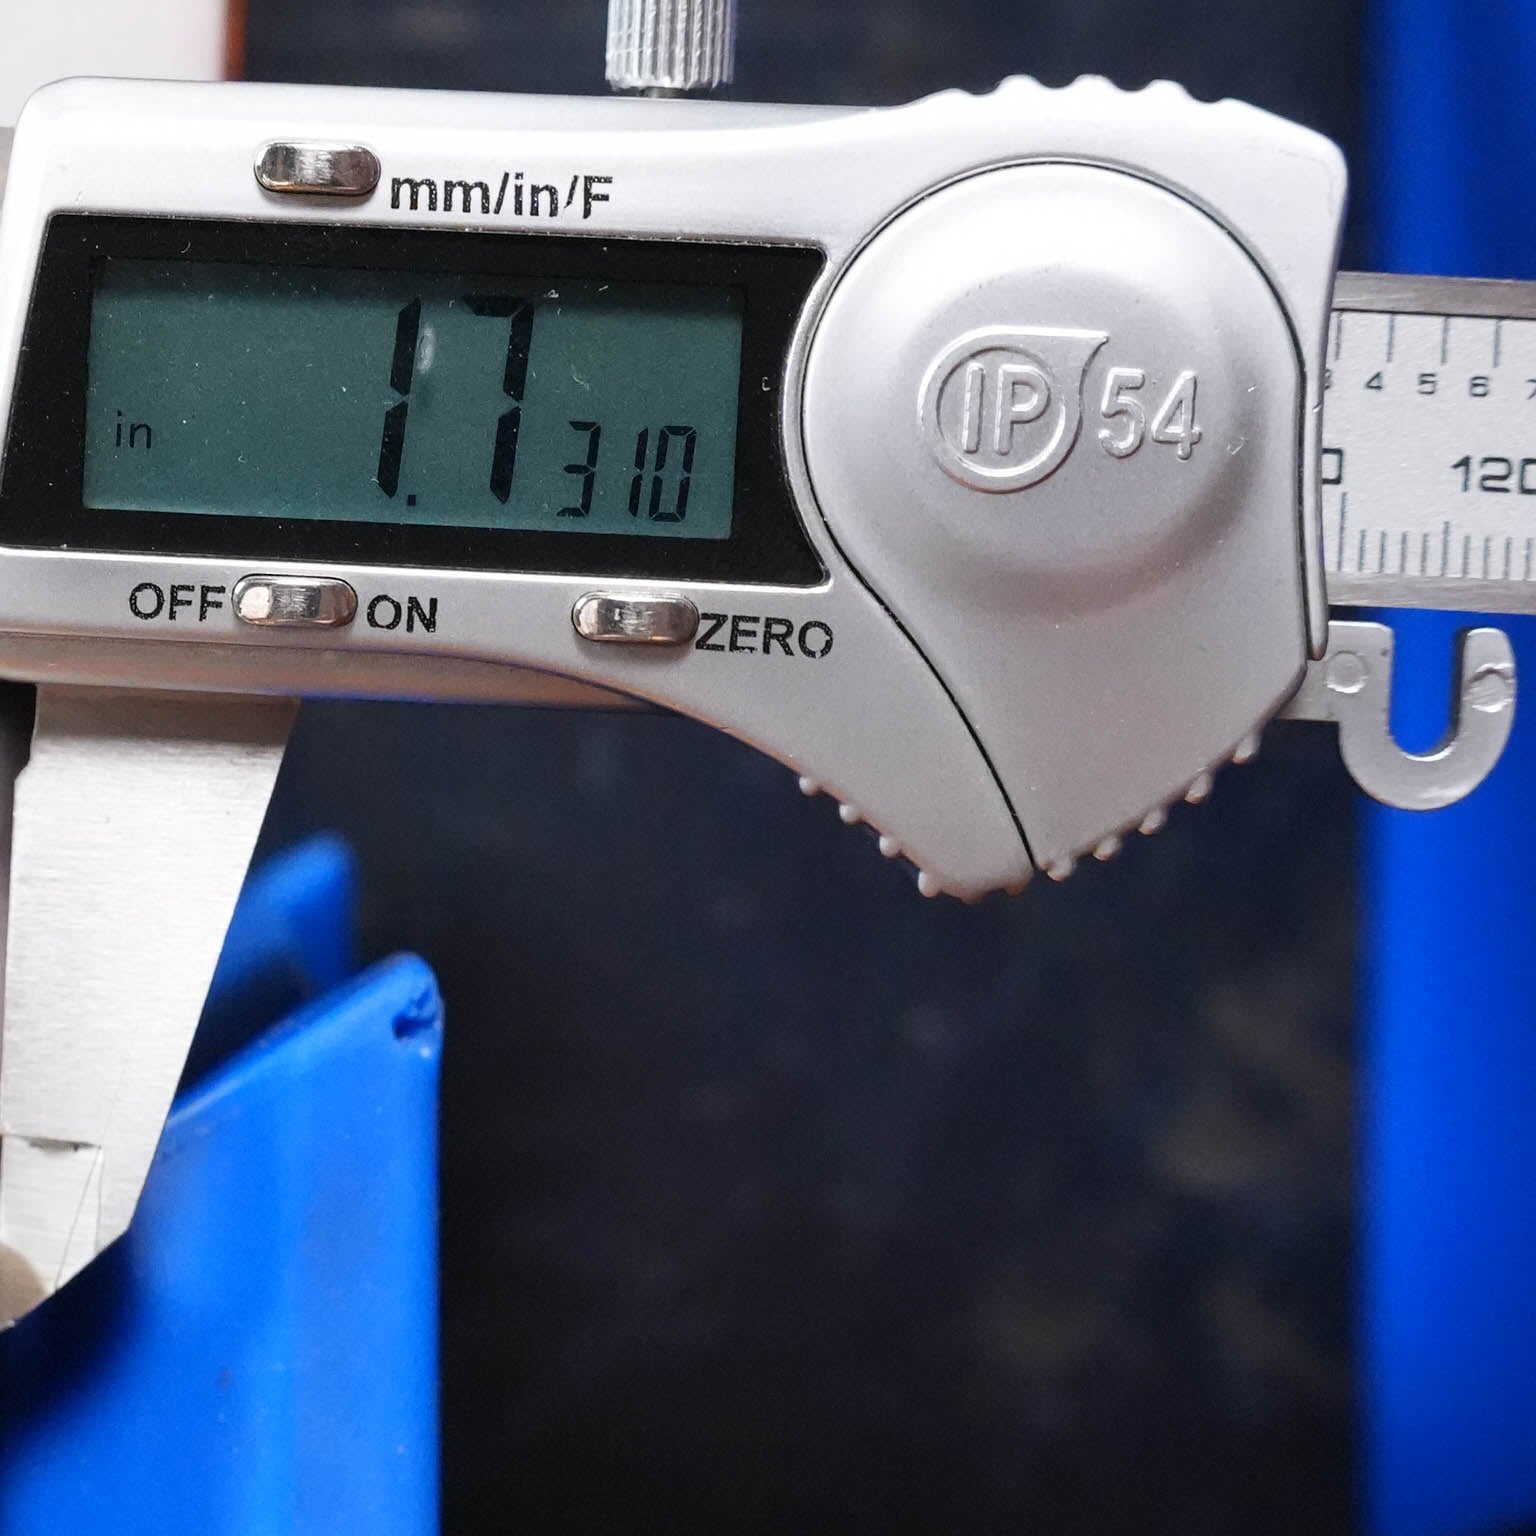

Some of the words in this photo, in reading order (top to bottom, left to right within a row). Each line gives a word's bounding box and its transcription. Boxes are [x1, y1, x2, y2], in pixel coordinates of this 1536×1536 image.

[390, 172, 614, 219] mm/in/F
[1366, 371, 1382, 391] 4
[1418, 373, 1437, 395] 5
[1470, 376, 1489, 397] 6
[114, 410, 152, 449] in
[961, 361, 1051, 455] IP
[1097, 366, 1203, 461] 54
[128, 582, 225, 622] OFF
[366, 594, 438, 634] ON
[695, 612, 833, 660] ZERO
